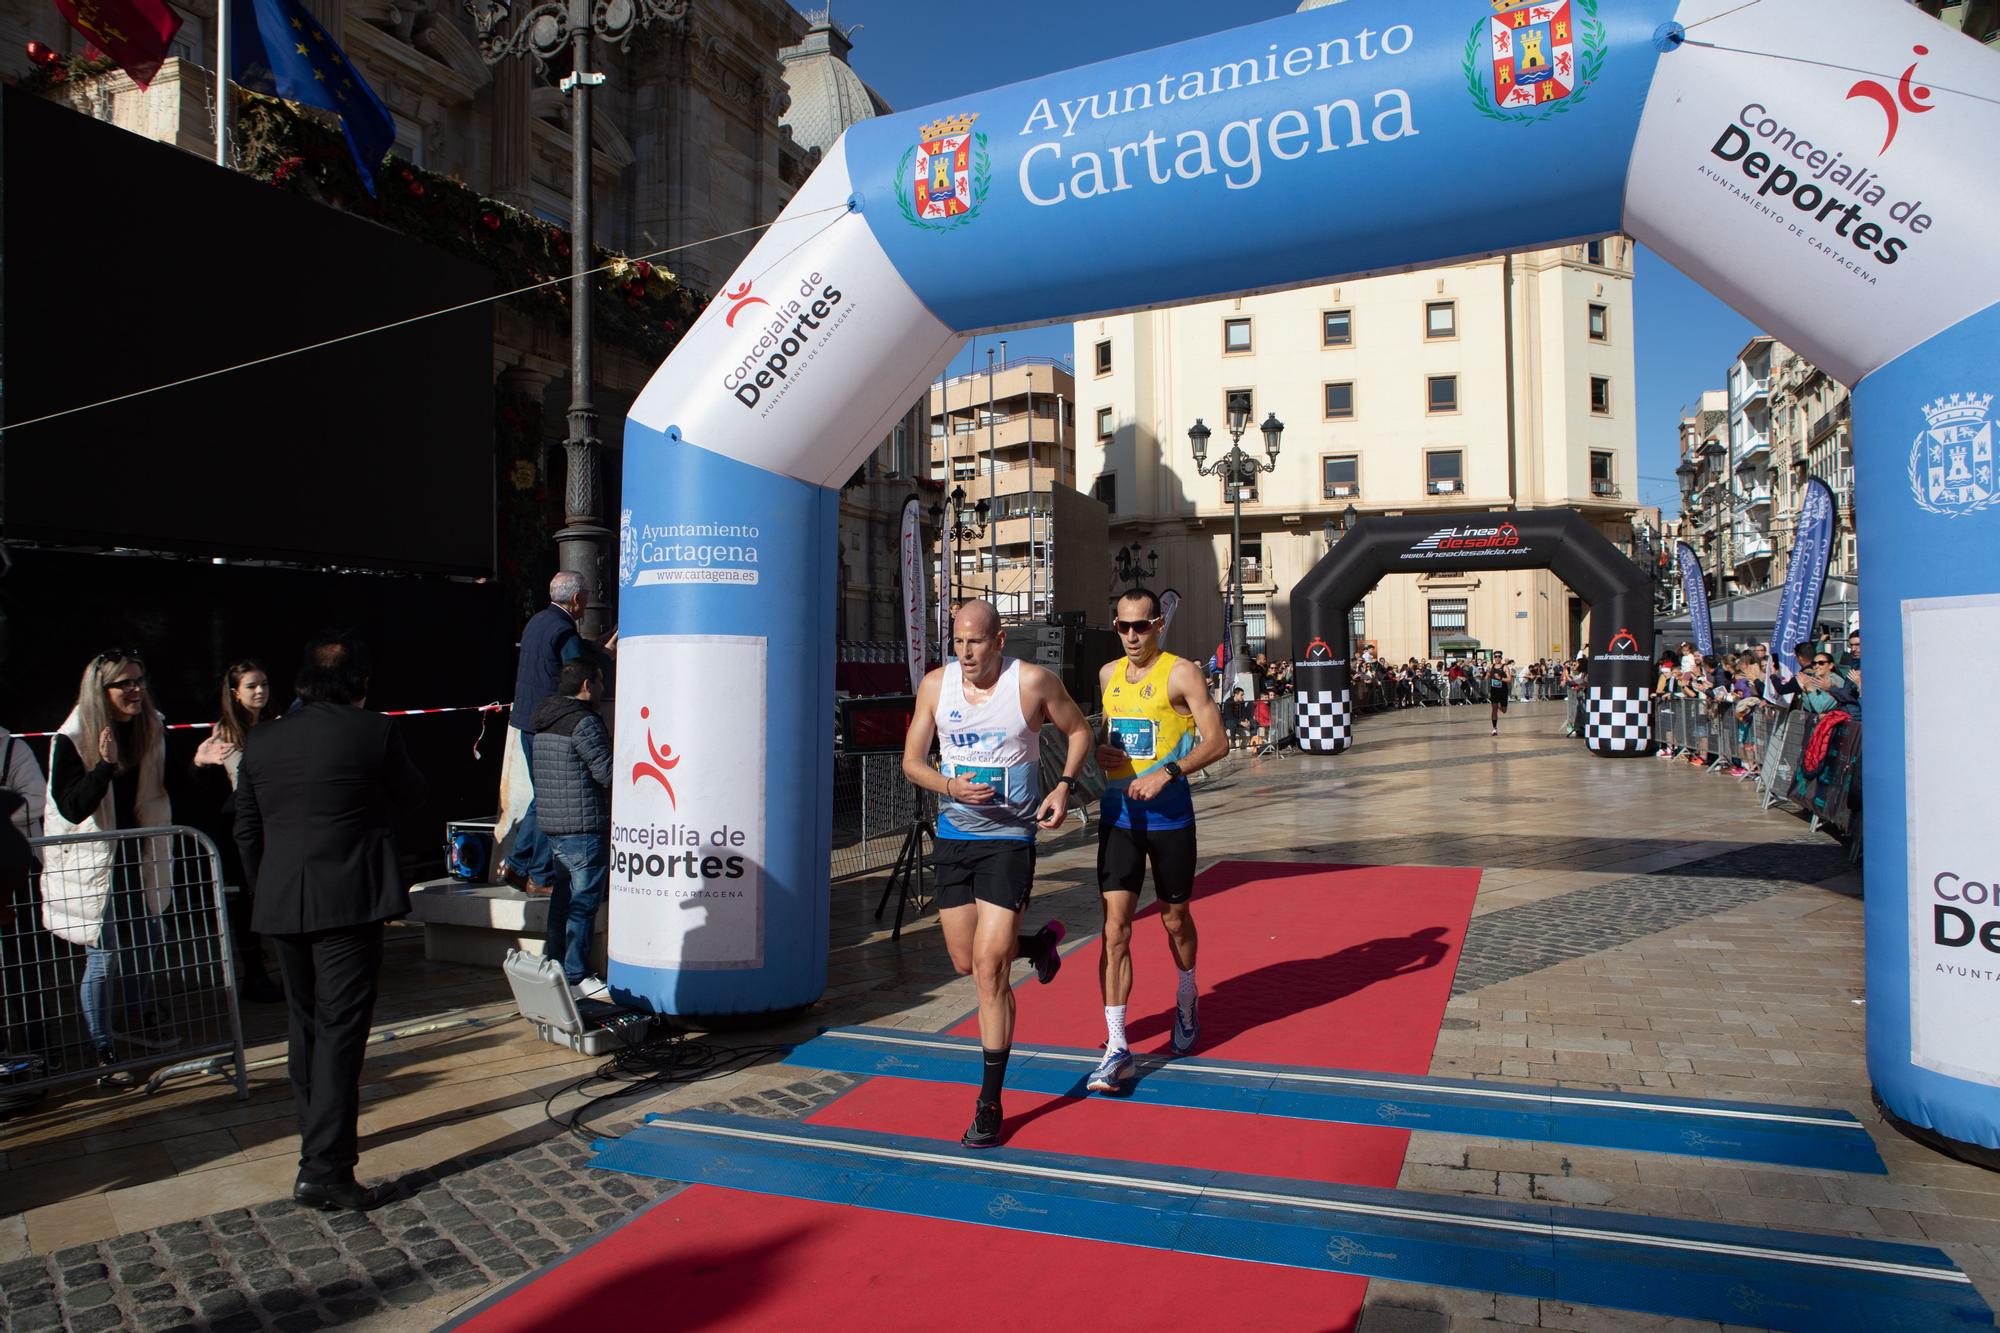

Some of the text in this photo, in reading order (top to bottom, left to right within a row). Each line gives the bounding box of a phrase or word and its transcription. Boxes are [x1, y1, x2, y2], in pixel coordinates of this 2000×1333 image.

[1018, 24, 1414, 137] Ayuntamiento
[1018, 87, 1420, 206] Cartagena
[1739, 103, 1932, 234] Concejalía de
[1697, 164, 1878, 286] AYUNTAMIENTO DE CARTAGENA
[1710, 123, 1908, 265] Deportes
[723, 271, 823, 391] Concejalía de
[734, 284, 842, 409] Deportes
[761, 302, 856, 419] AYUNTAMIENTO DE CARTAGENA
[641, 522, 760, 541] Ayuntamiento
[641, 543, 759, 566] Cartagena
[1400, 547, 1532, 559] www.lineadesalida.net
[1452, 525, 1498, 538] Línea
[656, 569, 755, 582] www.cartagena.es
[950, 731, 1007, 751] UPCT
[710, 825, 745, 847] de
[656, 889, 669, 897] DE
[674, 890, 744, 899] CARTAGENA
